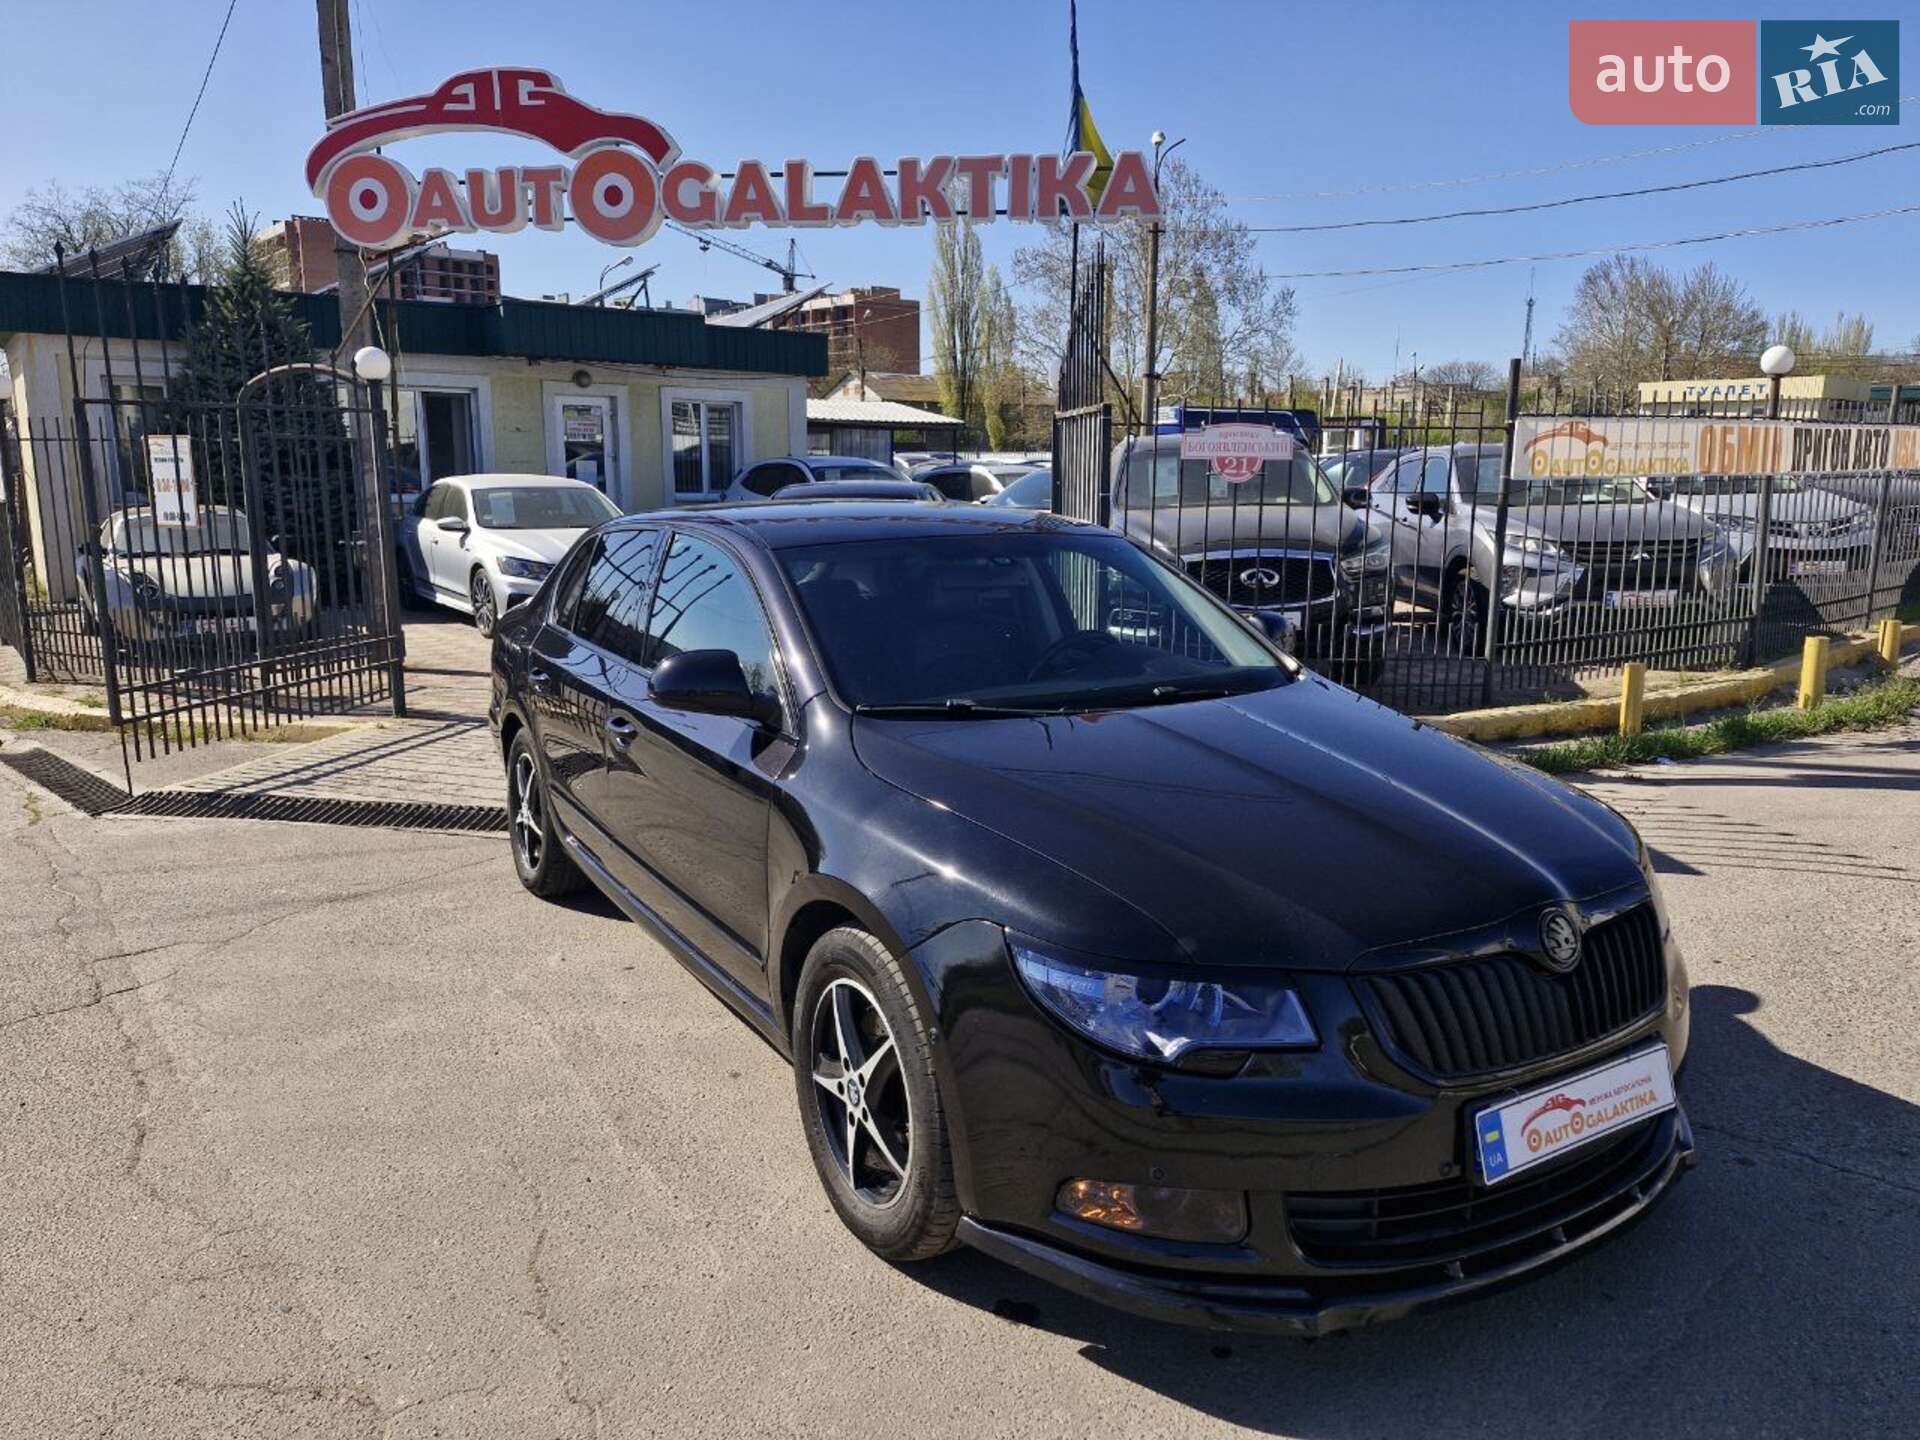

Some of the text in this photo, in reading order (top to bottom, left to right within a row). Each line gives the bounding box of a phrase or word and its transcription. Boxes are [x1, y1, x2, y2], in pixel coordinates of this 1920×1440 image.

[1685, 383, 1767, 397] ТУАЛЕТ
[1700, 425, 1783, 475] ОБМІН
[1791, 427, 1891, 473] ПРИГОН АВТО
[1224, 456, 1250, 474] 21
[1489, 1152, 1504, 1168] UA
